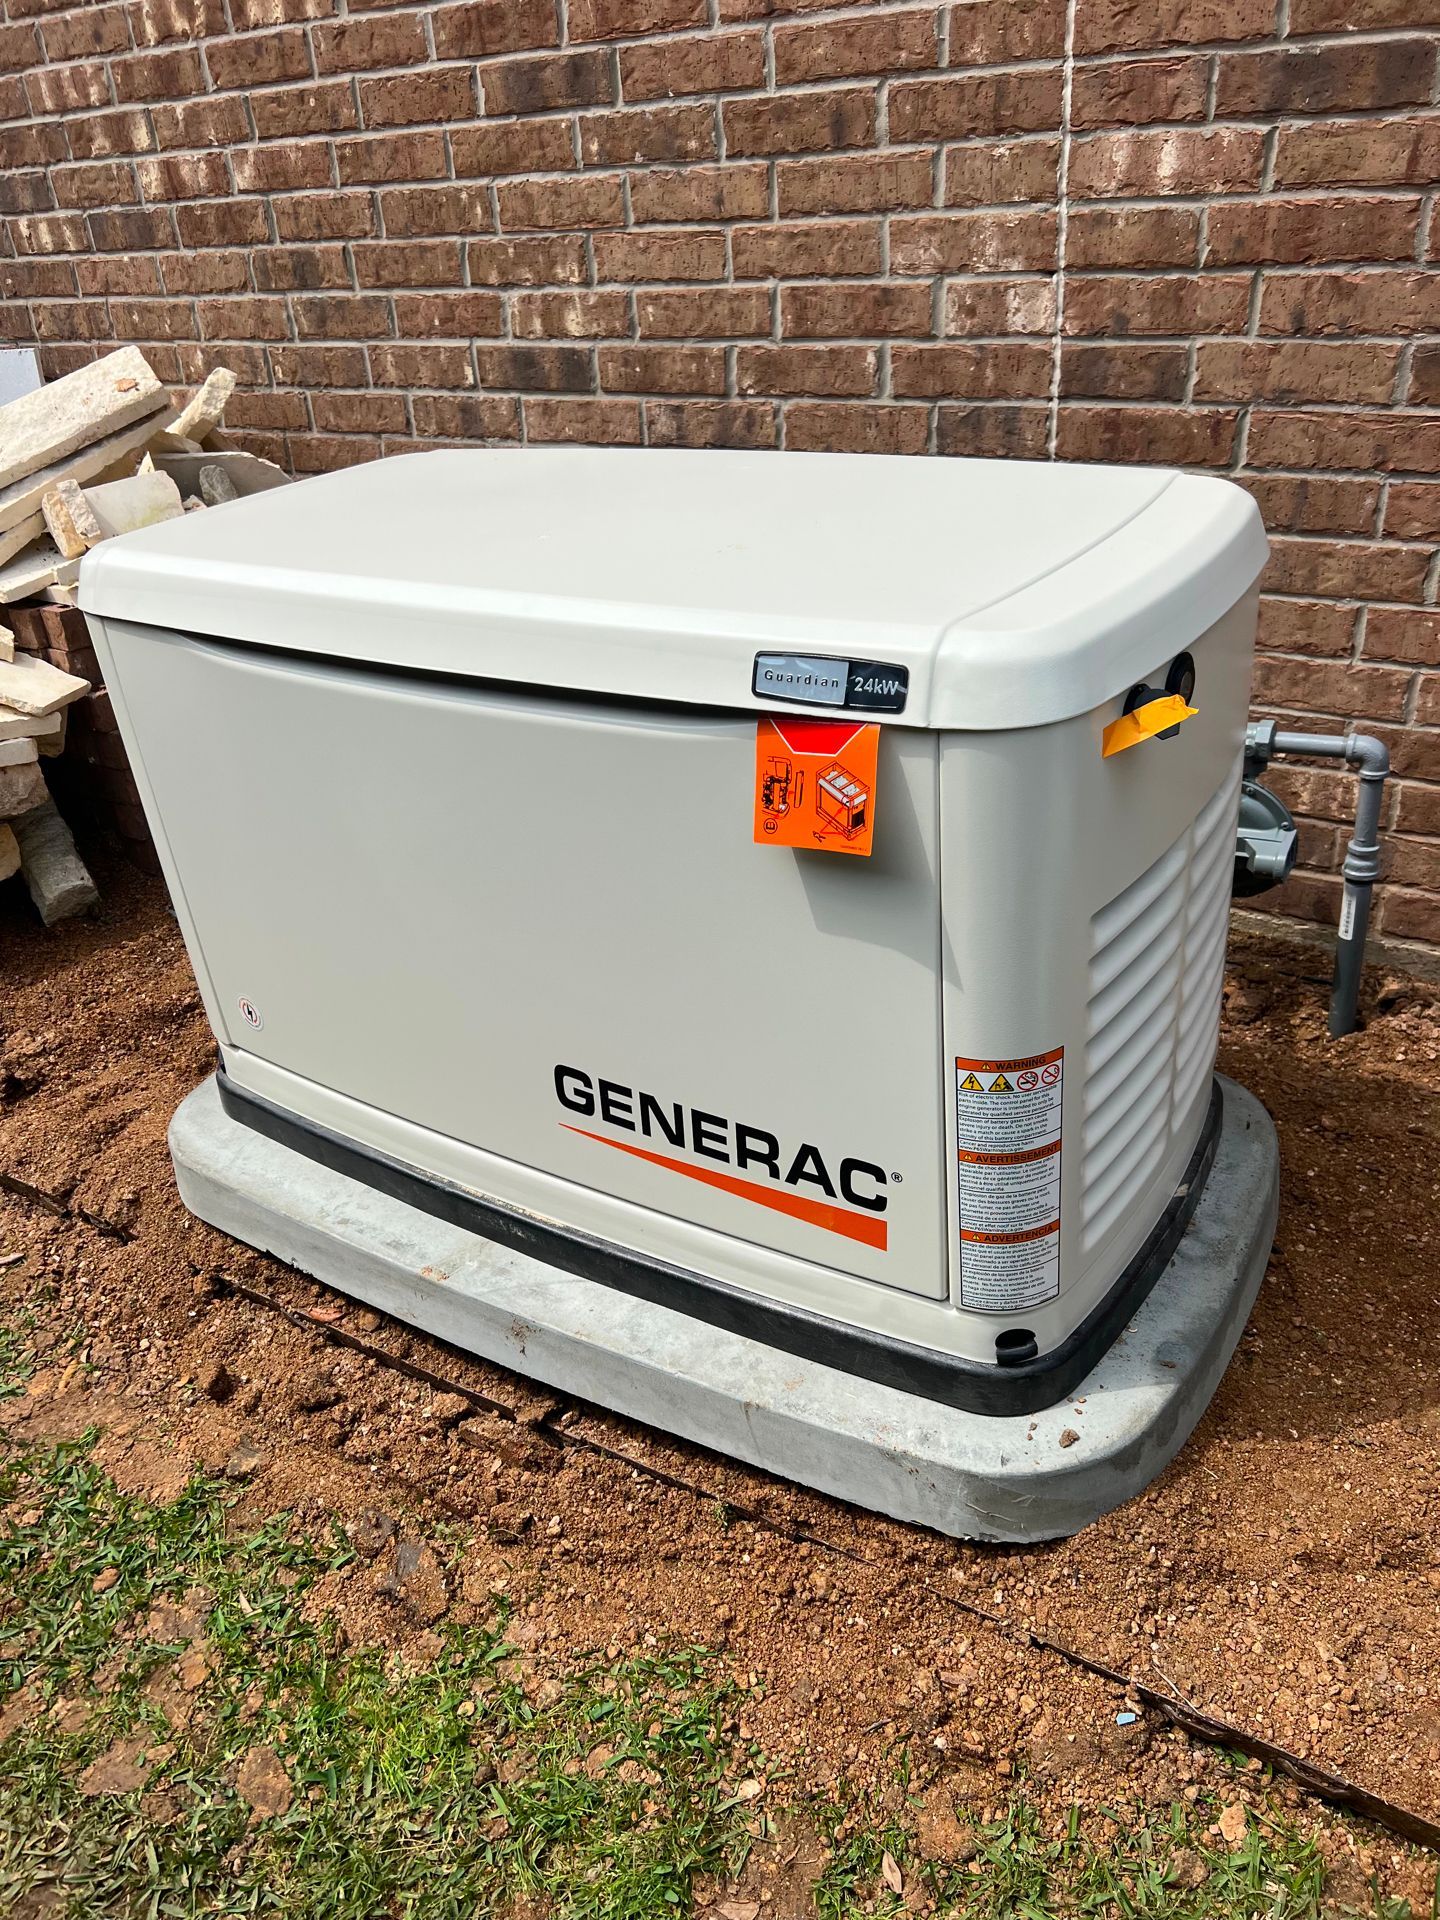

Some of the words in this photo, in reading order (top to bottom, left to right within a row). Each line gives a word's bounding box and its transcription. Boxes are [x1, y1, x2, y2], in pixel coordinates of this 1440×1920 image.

[764, 670, 840, 688] Guardian
[854, 677, 899, 696] 24kW
[996, 1056, 1046, 1070] WARNING
[554, 1064, 888, 1212] GENERAC
[976, 1144, 1058, 1162] AVERTISSEMENT
[984, 1226, 1053, 1242] ADVERTENCIA
